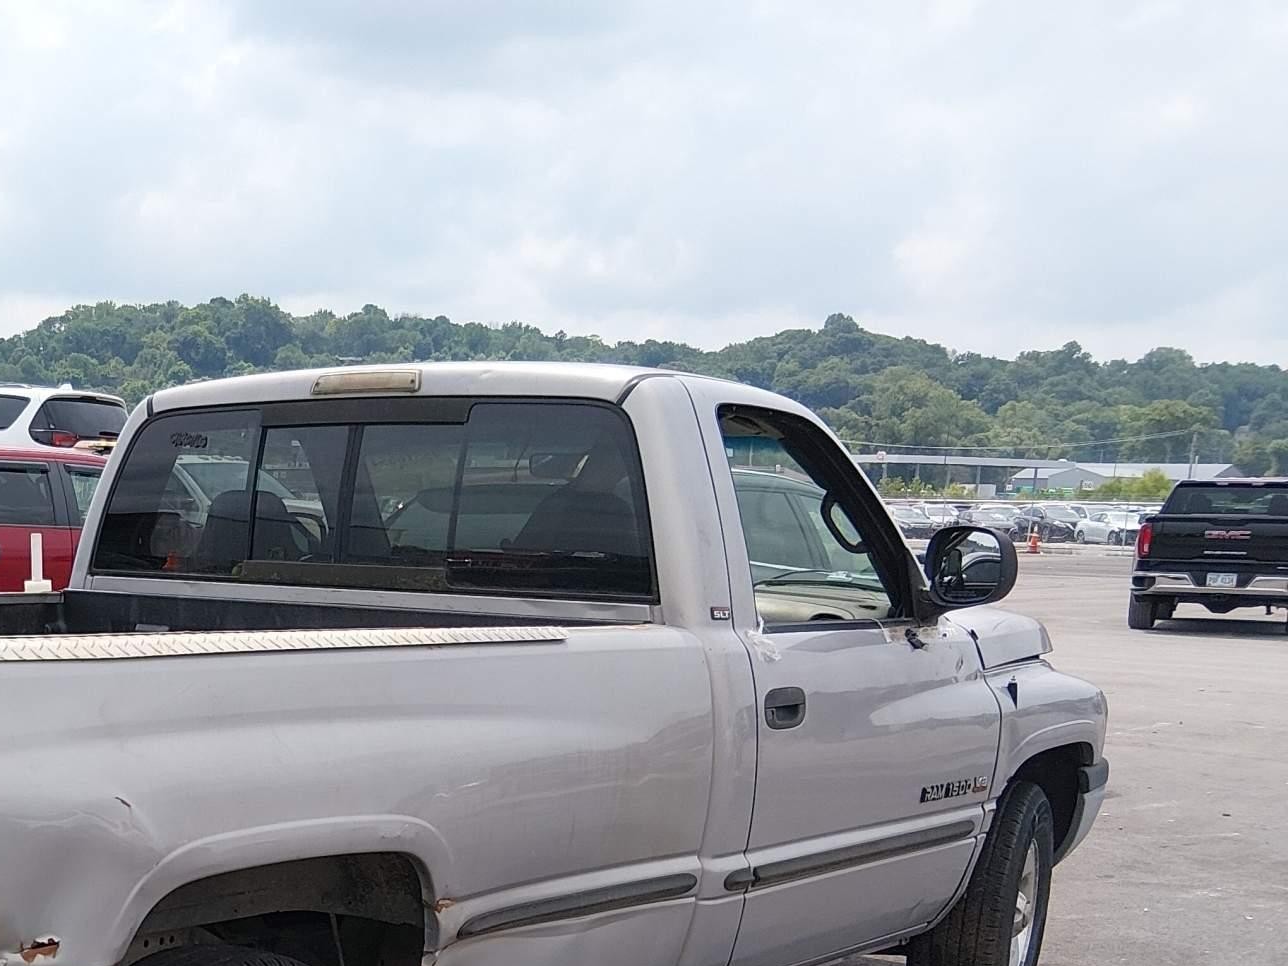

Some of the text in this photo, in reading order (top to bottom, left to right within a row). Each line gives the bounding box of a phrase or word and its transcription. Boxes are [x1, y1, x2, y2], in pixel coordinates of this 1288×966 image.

[1204, 530, 1252, 540] GMC
[713, 610, 729, 619] SLT
[920, 785, 944, 803] RAM
